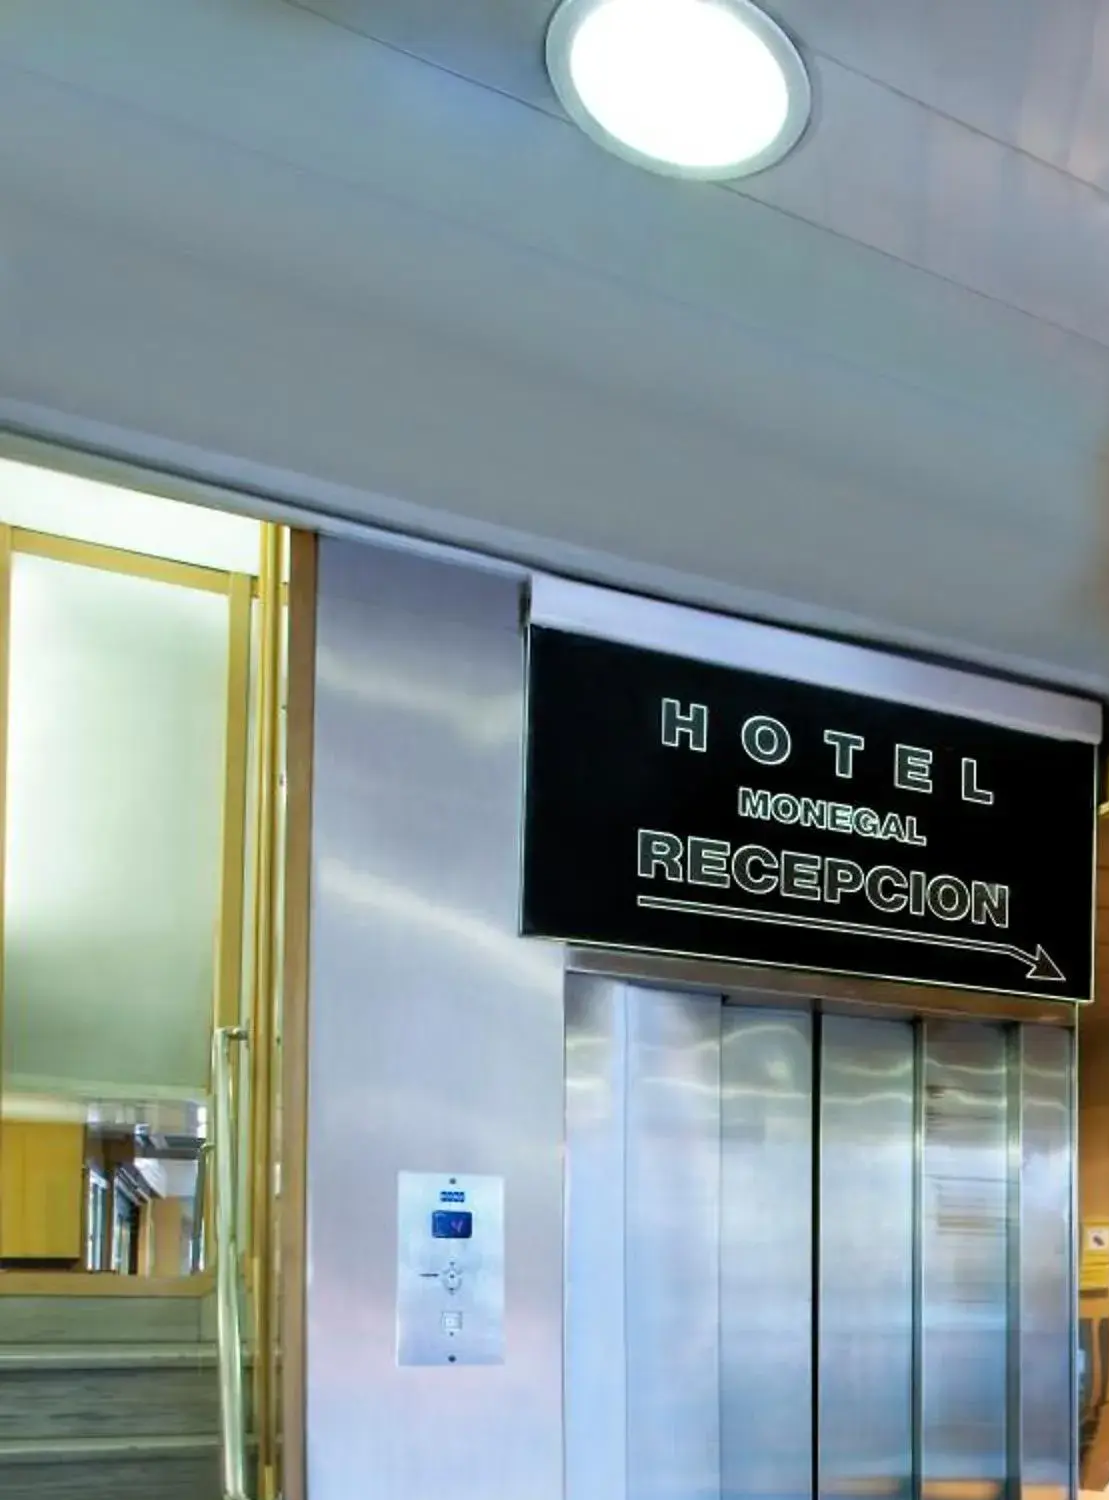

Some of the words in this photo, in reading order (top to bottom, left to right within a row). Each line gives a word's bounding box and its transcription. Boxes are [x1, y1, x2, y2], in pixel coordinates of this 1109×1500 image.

[660, 697, 995, 806] HOTEL
[737, 787, 927, 846] MONEGAL
[636, 828, 1010, 929] RECEPCION
